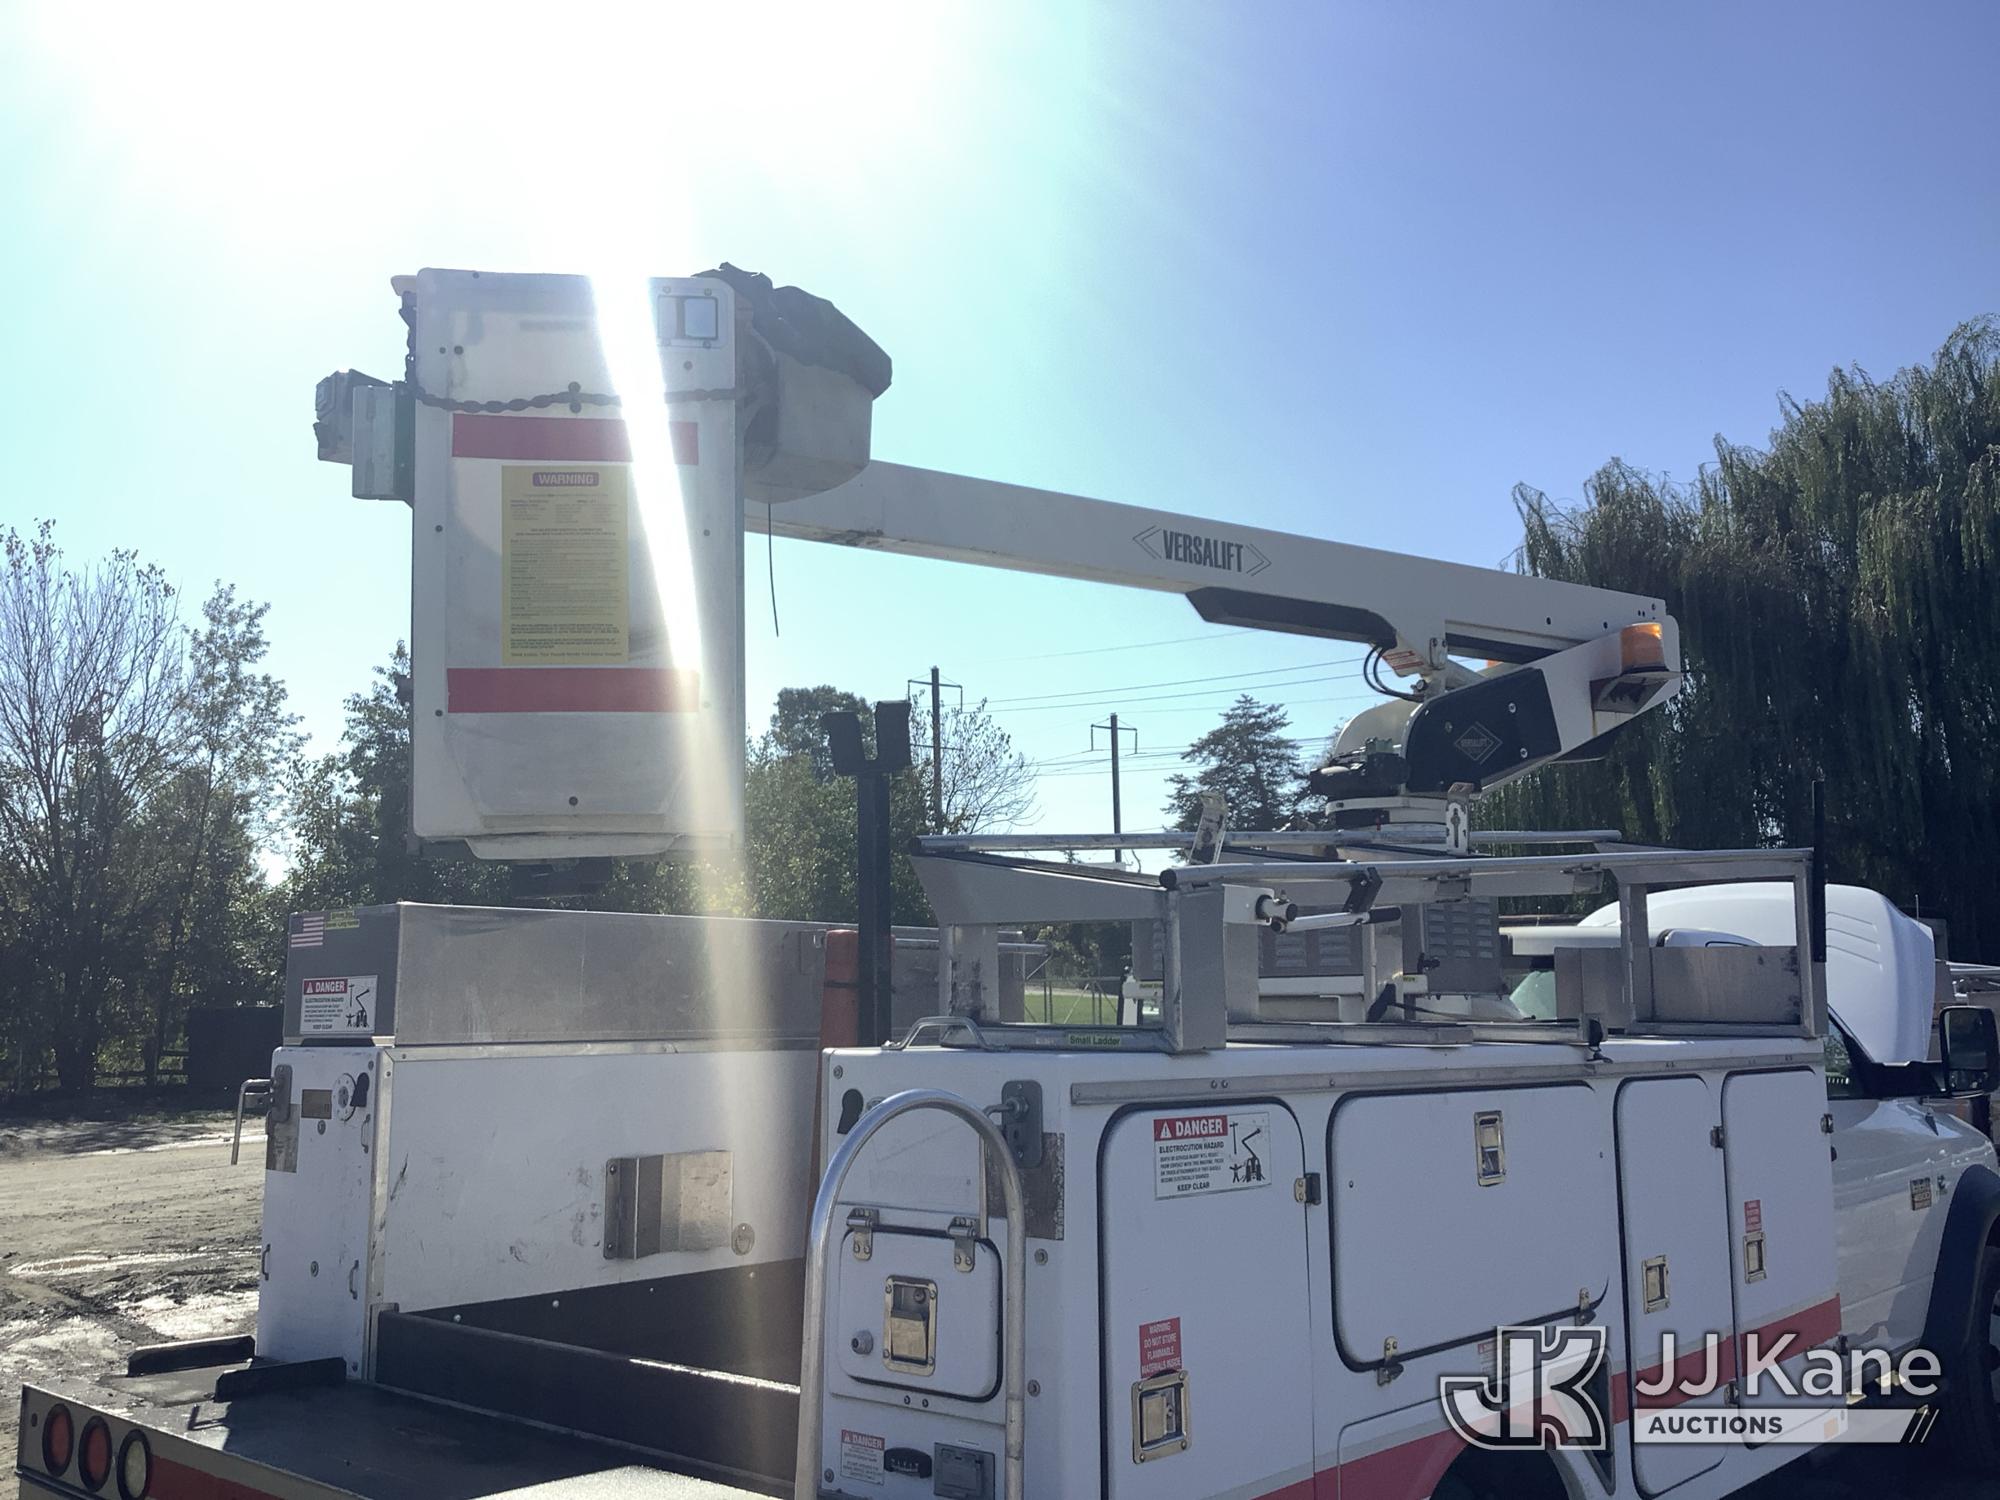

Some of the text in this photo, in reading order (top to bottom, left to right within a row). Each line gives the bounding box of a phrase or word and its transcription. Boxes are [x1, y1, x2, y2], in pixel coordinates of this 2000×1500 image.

[538, 473, 594, 485] WARNING
[1163, 530, 1243, 573] VERSALIFT
[315, 981, 345, 993] DANGER
[1070, 1035, 1120, 1046] Small Ladder
[1175, 1119, 1223, 1136] DANGER
[1159, 1141, 1224, 1153] ELECTROCUTION HAZARD
[1193, 1181, 1210, 1190] CLEAR
[852, 1433, 882, 1449] DANGER
